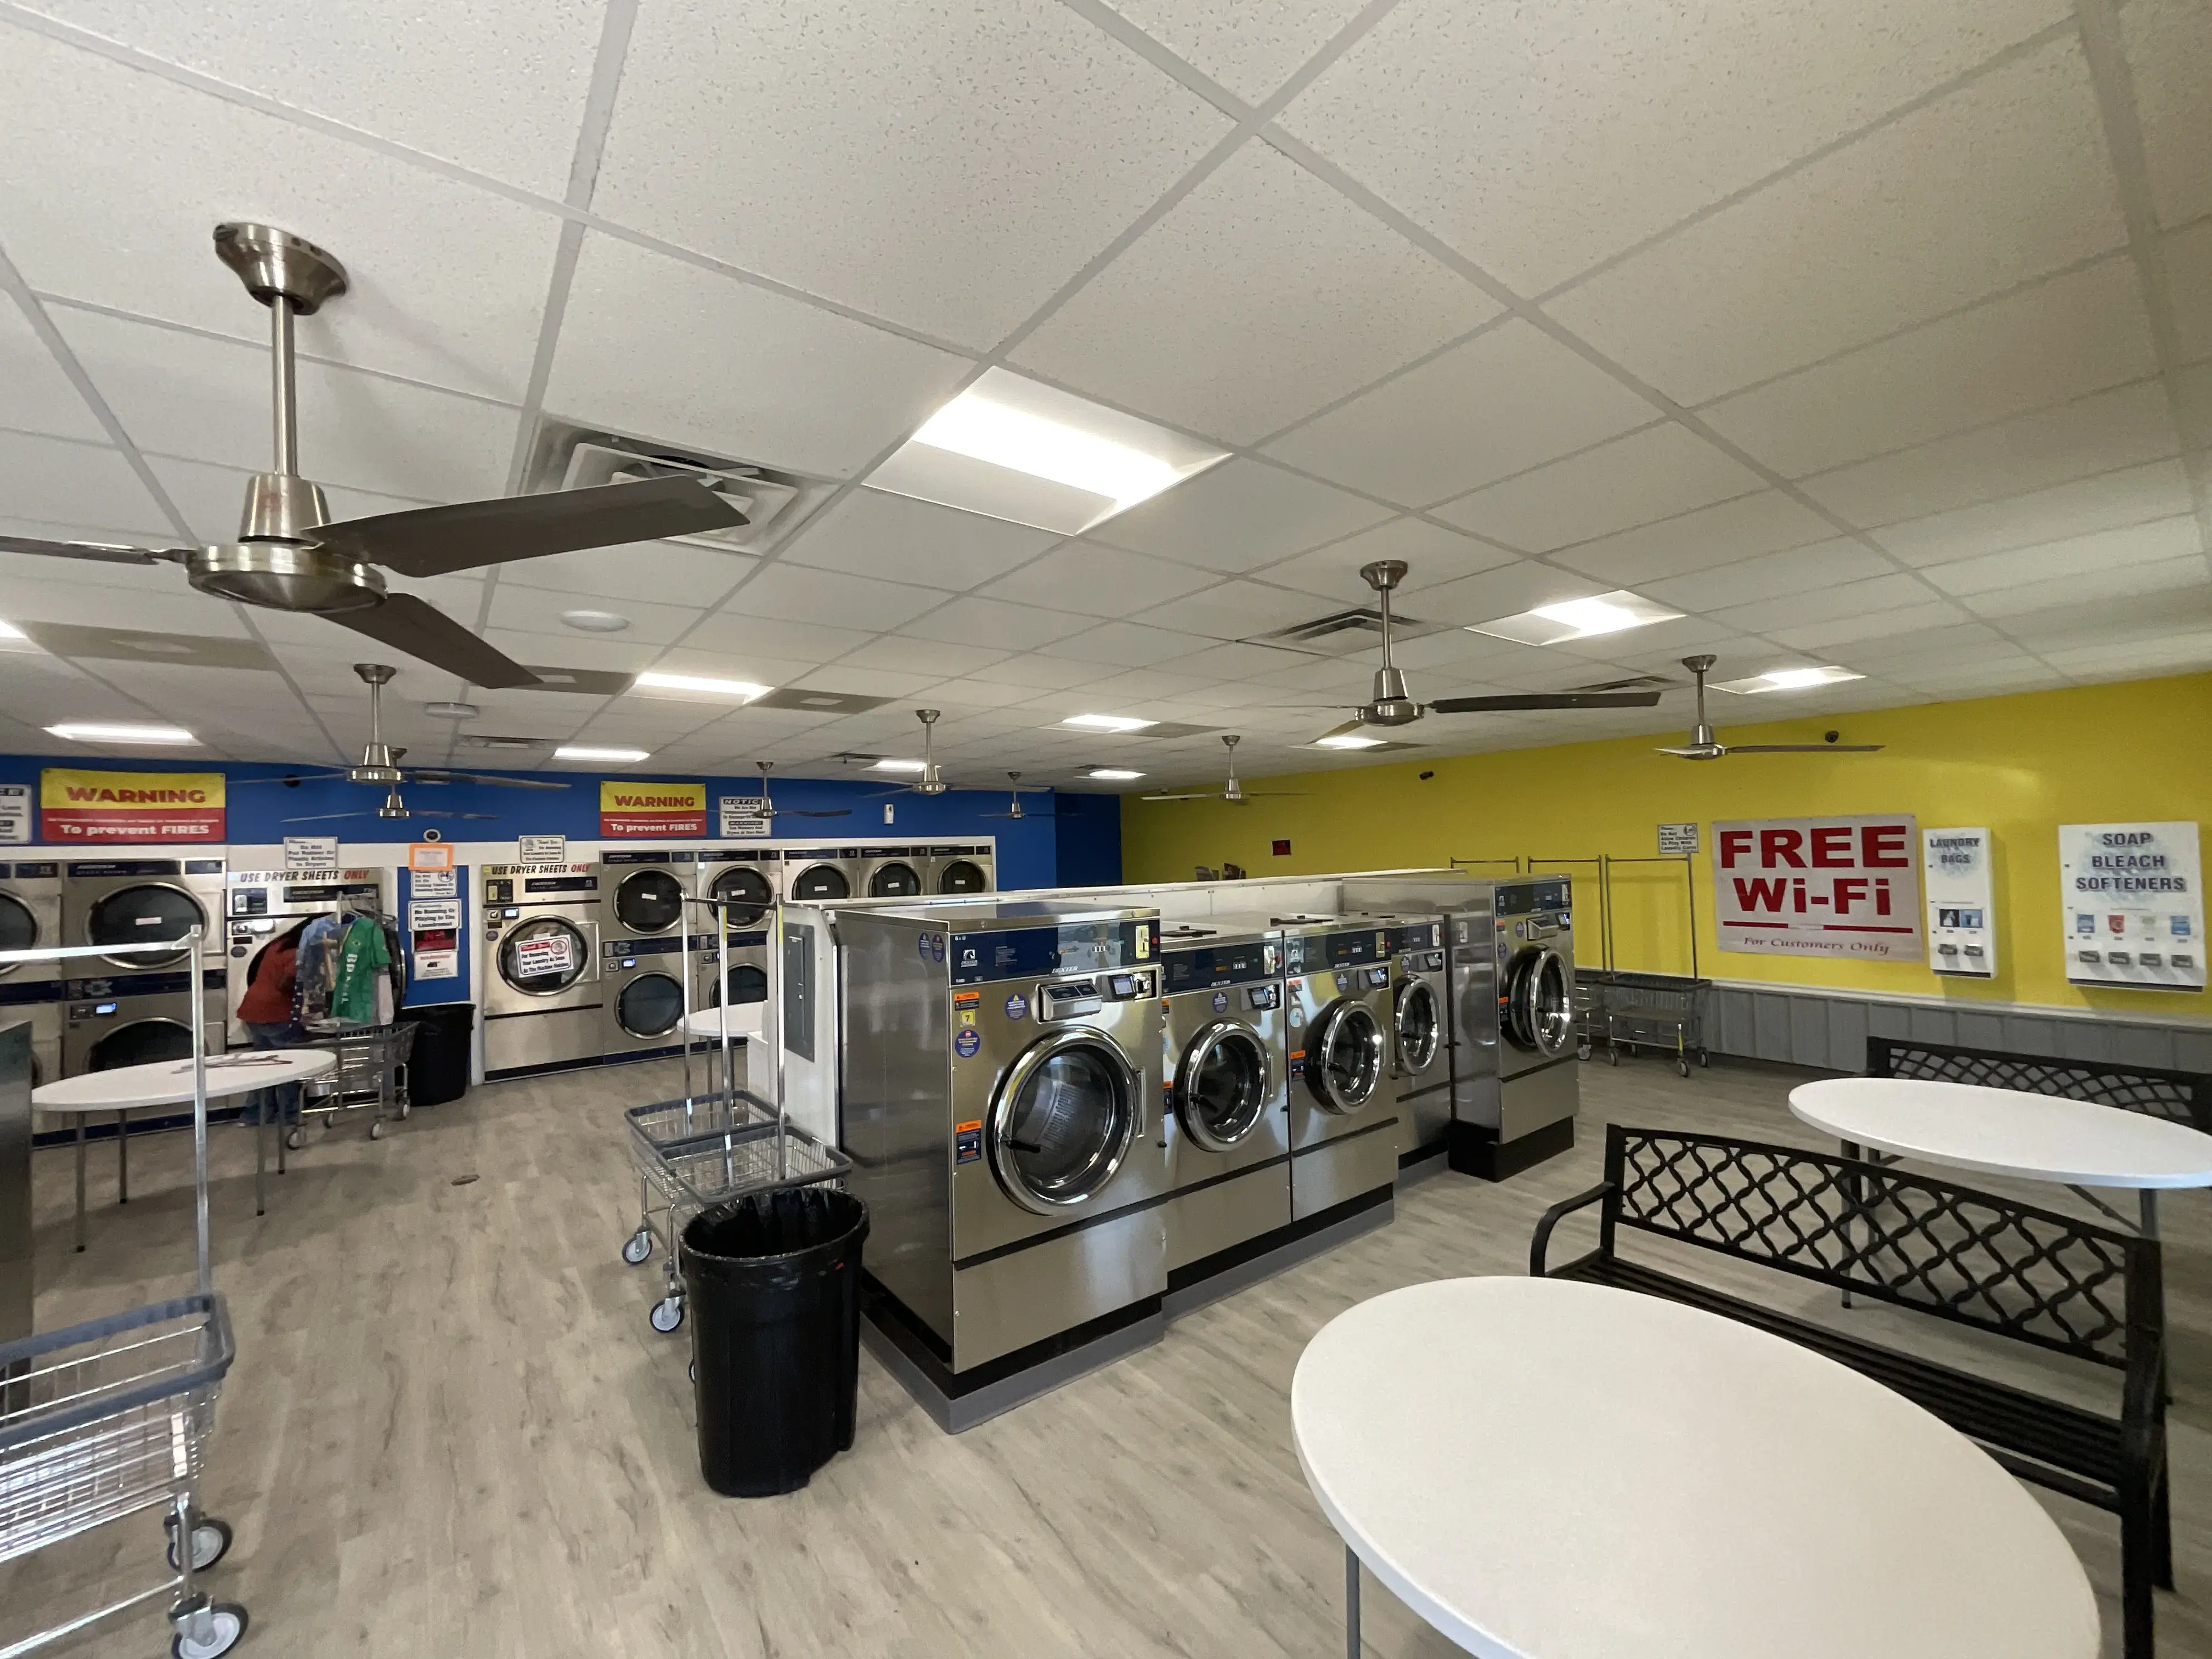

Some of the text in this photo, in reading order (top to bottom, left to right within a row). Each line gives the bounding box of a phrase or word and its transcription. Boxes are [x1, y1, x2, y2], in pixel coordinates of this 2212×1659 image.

[66, 787, 206, 803] WARNING
[614, 795, 695, 807] WARNING
[61, 825, 210, 836] To prevent FIRES
[627, 824, 667, 832] prevent
[1929, 838, 1980, 848] LAUNDRY
[2102, 832, 2153, 847] SOAP
[1720, 825, 1909, 868] FREE
[1942, 854, 1971, 863] BAGS
[2091, 855, 2165, 868] BLEACH
[492, 864, 591, 874] USE DRYER SHEETS ONLY
[239, 870, 370, 883] USE DRYER SHEETS ONLY
[2076, 877, 2186, 891] SOFTENERS
[1733, 878, 1891, 915] Wi-Fi
[1743, 937, 1890, 955] For Customers Only
